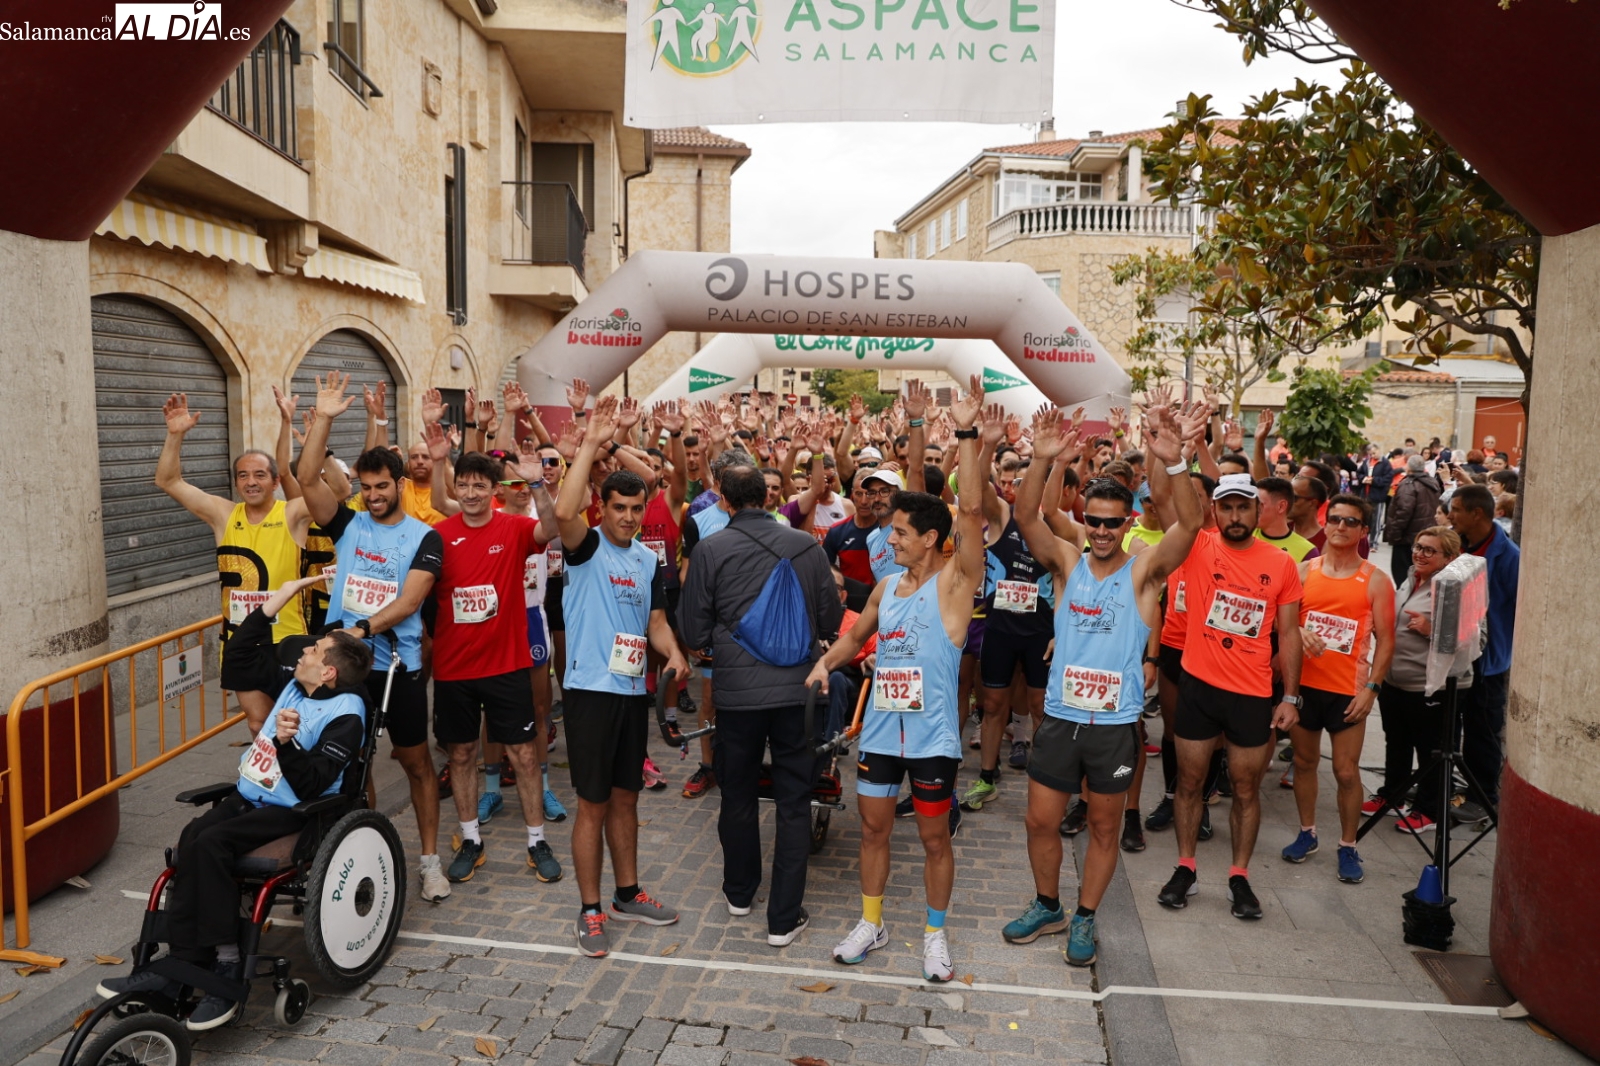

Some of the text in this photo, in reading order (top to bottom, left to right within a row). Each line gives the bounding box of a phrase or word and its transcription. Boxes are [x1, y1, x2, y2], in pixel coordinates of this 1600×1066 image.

[783, 0, 1040, 33] ASPACE
[785, 42, 1038, 63] SALAMANCA
[763, 269, 915, 301] HOSPES
[707, 307, 968, 329] PALACIO DE SAN ESTEBAN
[567, 330, 643, 347] bedunia
[1023, 346, 1096, 363] bedunia
[347, 577, 397, 594] bedunia
[356, 589, 386, 607] 189
[462, 598, 488, 613] 220
[1005, 591, 1028, 604] 139
[1223, 606, 1251, 626] 166
[1315, 624, 1343, 642] 244
[627, 650, 644, 666] 49
[1065, 667, 1121, 686] bedunia
[883, 682, 910, 699] 132
[1074, 681, 1109, 701] 279
[332, 857, 355, 902] Pablo
